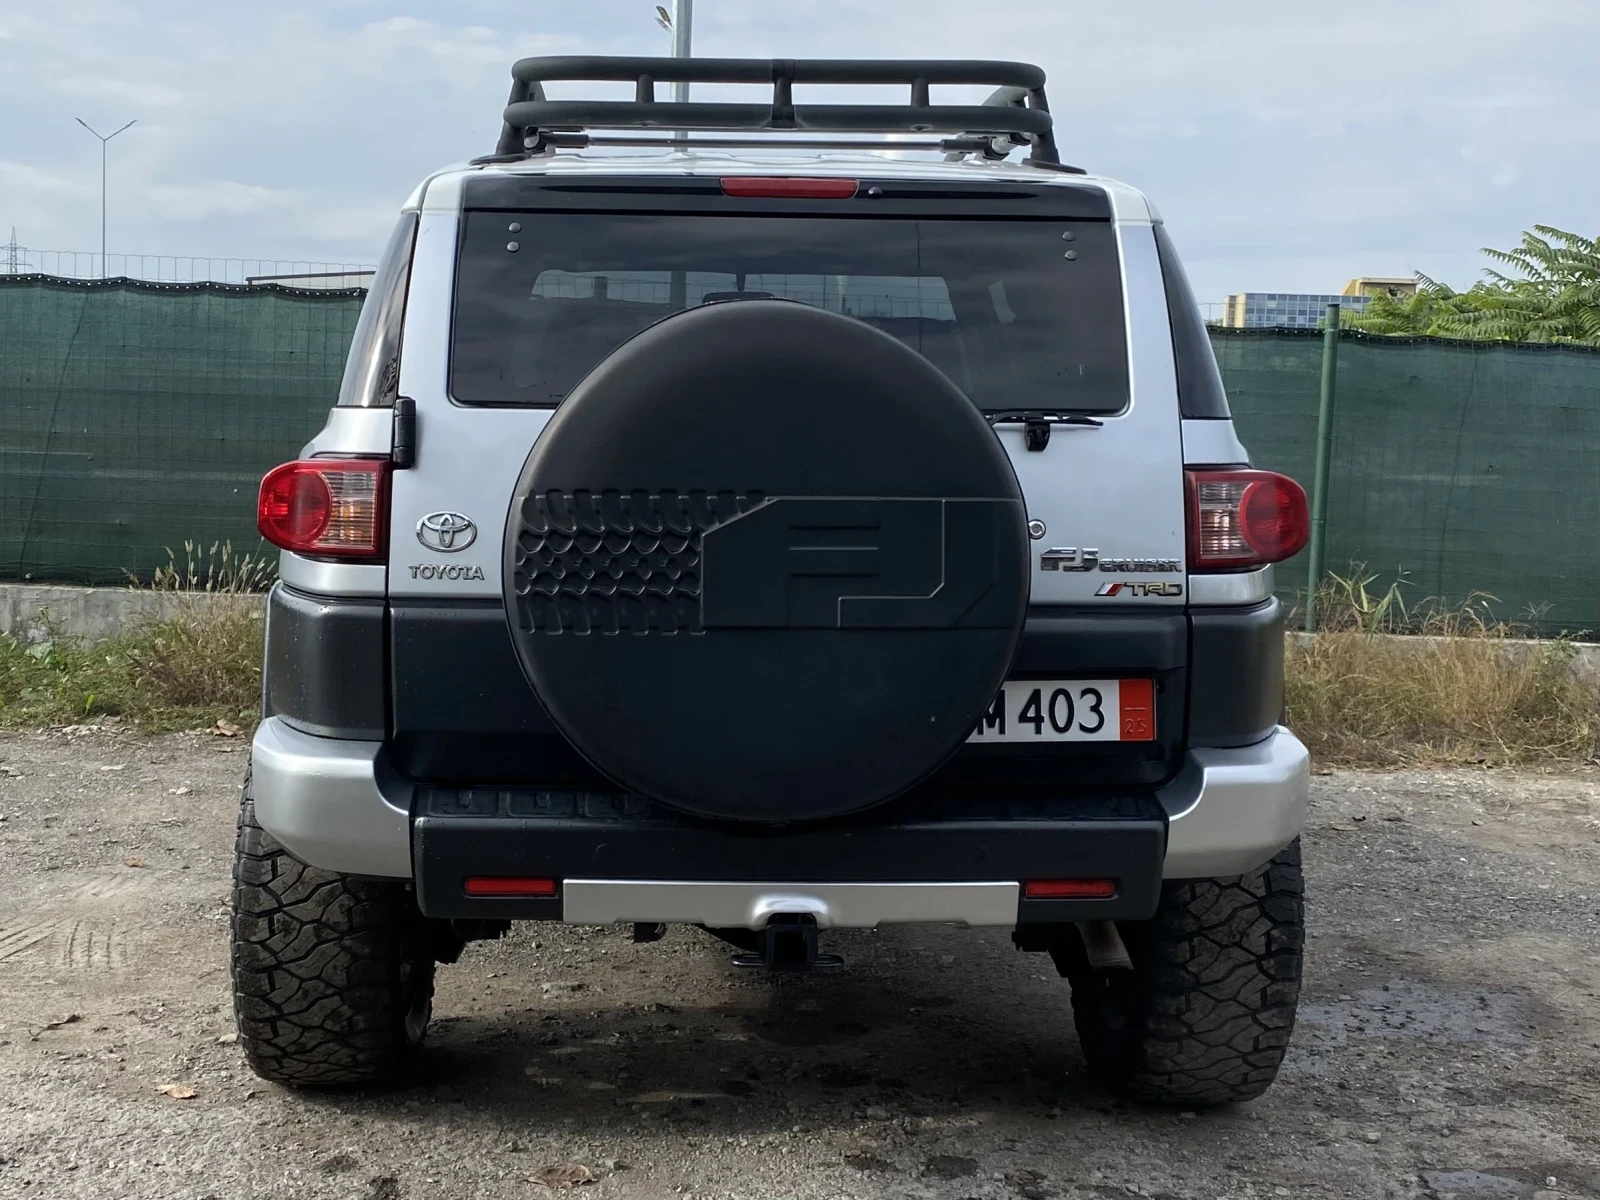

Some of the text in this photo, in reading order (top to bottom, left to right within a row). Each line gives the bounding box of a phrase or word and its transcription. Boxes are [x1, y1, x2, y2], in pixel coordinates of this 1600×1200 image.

[1041, 547, 1183, 573] FJ CRUISER
[408, 564, 484, 580] TOYOTA
[1122, 582, 1182, 597] TRD
[1018, 687, 1105, 734] 403
[1124, 718, 1148, 733] 25
